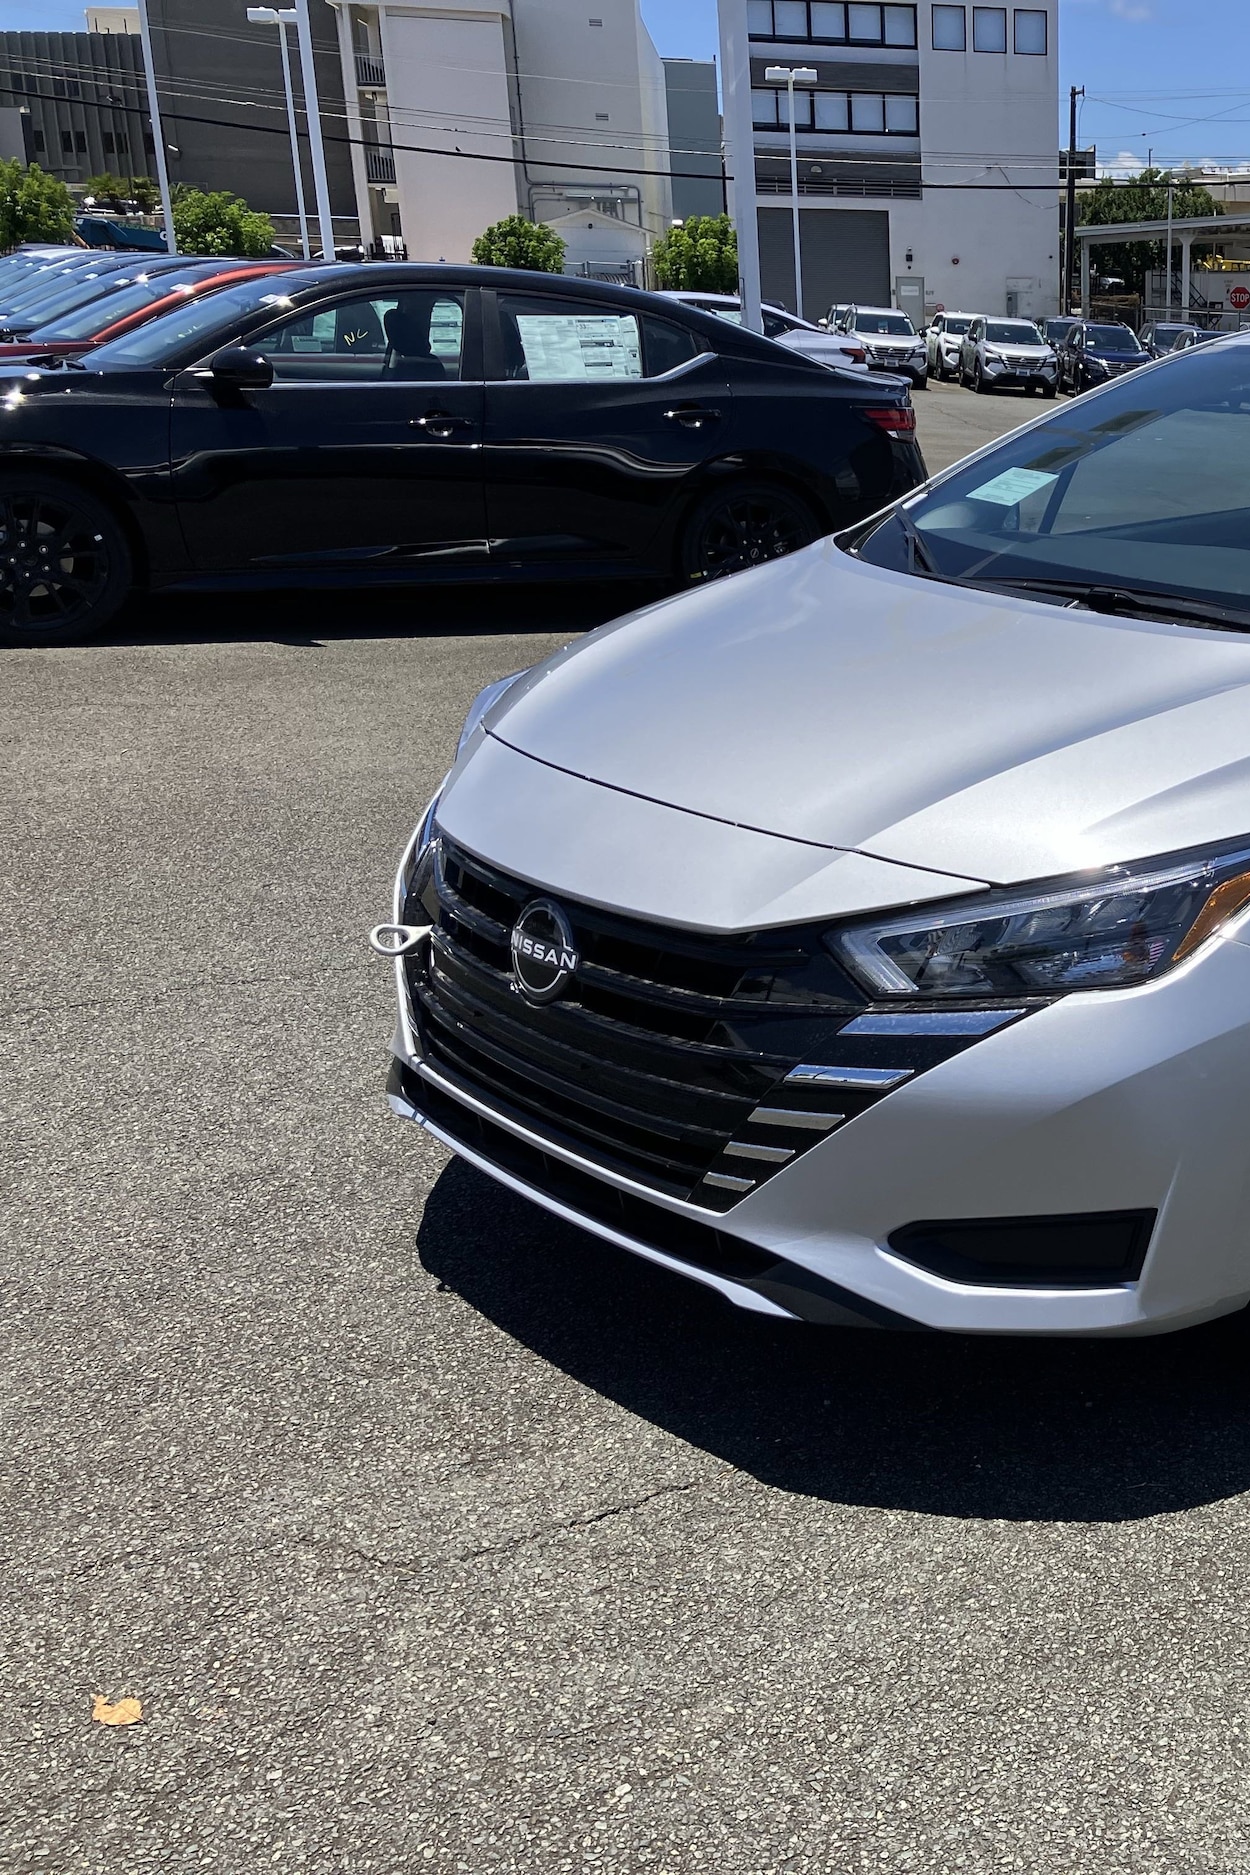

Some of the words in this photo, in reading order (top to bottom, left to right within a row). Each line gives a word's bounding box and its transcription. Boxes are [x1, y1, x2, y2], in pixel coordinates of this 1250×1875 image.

[1231, 293, 1250, 302] STOP
[343, 329, 369, 346] NC
[511, 930, 577, 969] NISSAN
